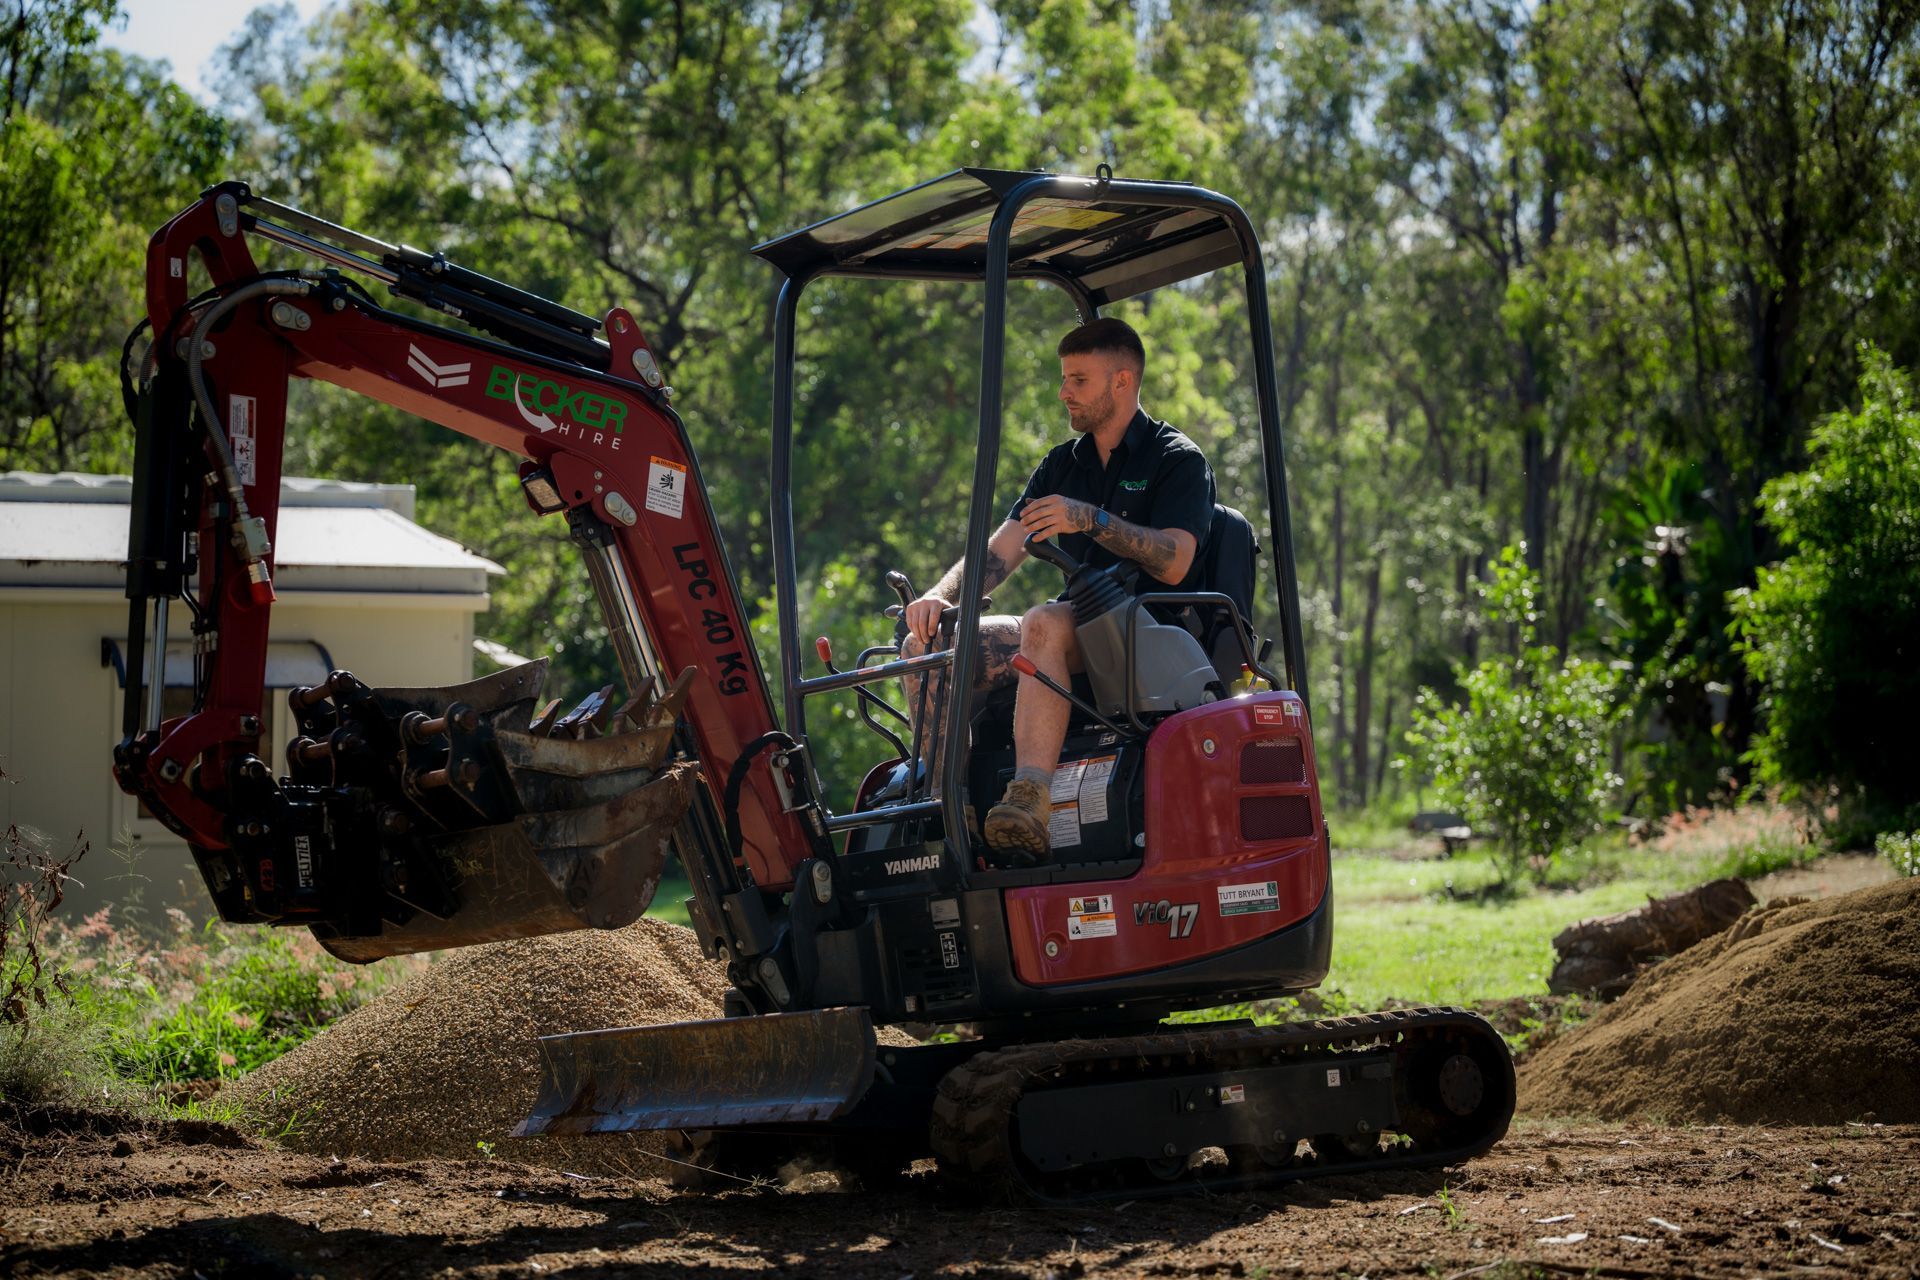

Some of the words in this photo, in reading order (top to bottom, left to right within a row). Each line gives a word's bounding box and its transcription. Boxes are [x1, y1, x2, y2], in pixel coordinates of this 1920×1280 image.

[485, 365, 628, 433] BECKER
[558, 422, 622, 450] HIRE
[672, 542, 717, 600] LPC
[702, 609, 735, 645] 40
[715, 651, 749, 696] Kg
[884, 854, 940, 876] YANMAR
[1219, 891, 1236, 900] TUTT
[1238, 888, 1264, 899] BRYANT
